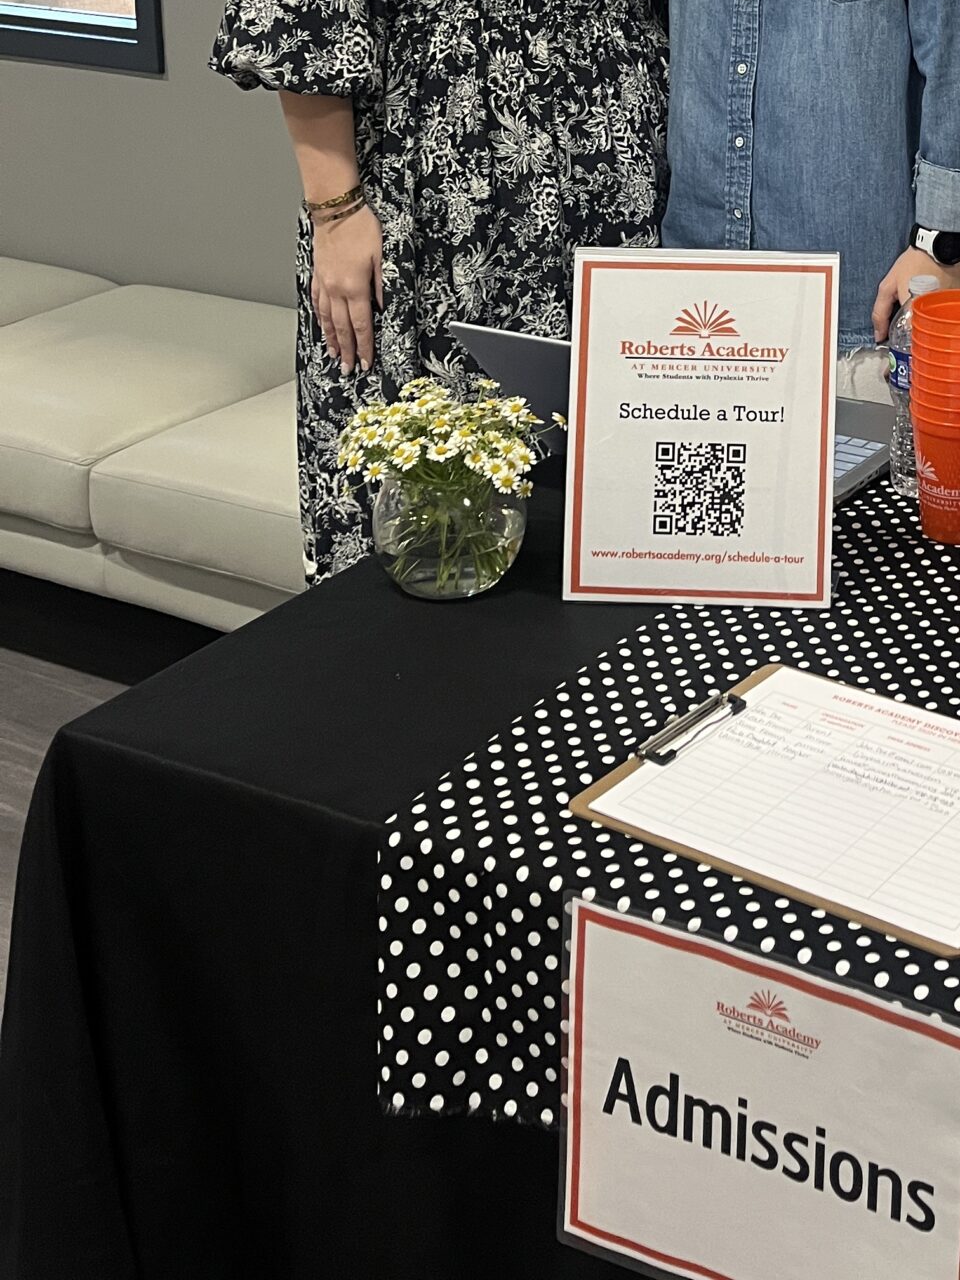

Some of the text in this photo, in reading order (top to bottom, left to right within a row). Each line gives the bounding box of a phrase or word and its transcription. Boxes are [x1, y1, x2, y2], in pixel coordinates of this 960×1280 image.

[620, 340, 789, 363] Roberts Academy
[631, 363, 776, 374] AT MERCER UNIVERSITY
[662, 373, 693, 381] Students
[695, 373, 711, 381] with
[713, 374, 744, 383] Dyslexia
[619, 403, 785, 422] Schedule a Tour!
[591, 548, 805, 566] www.robertsacademy.org/schedule-a-tour
[875, 707, 923, 726] ACADEMY
[716, 1001, 764, 1027] Roberts
[766, 1019, 821, 1050] Academy
[602, 1056, 937, 1233] Admissions
